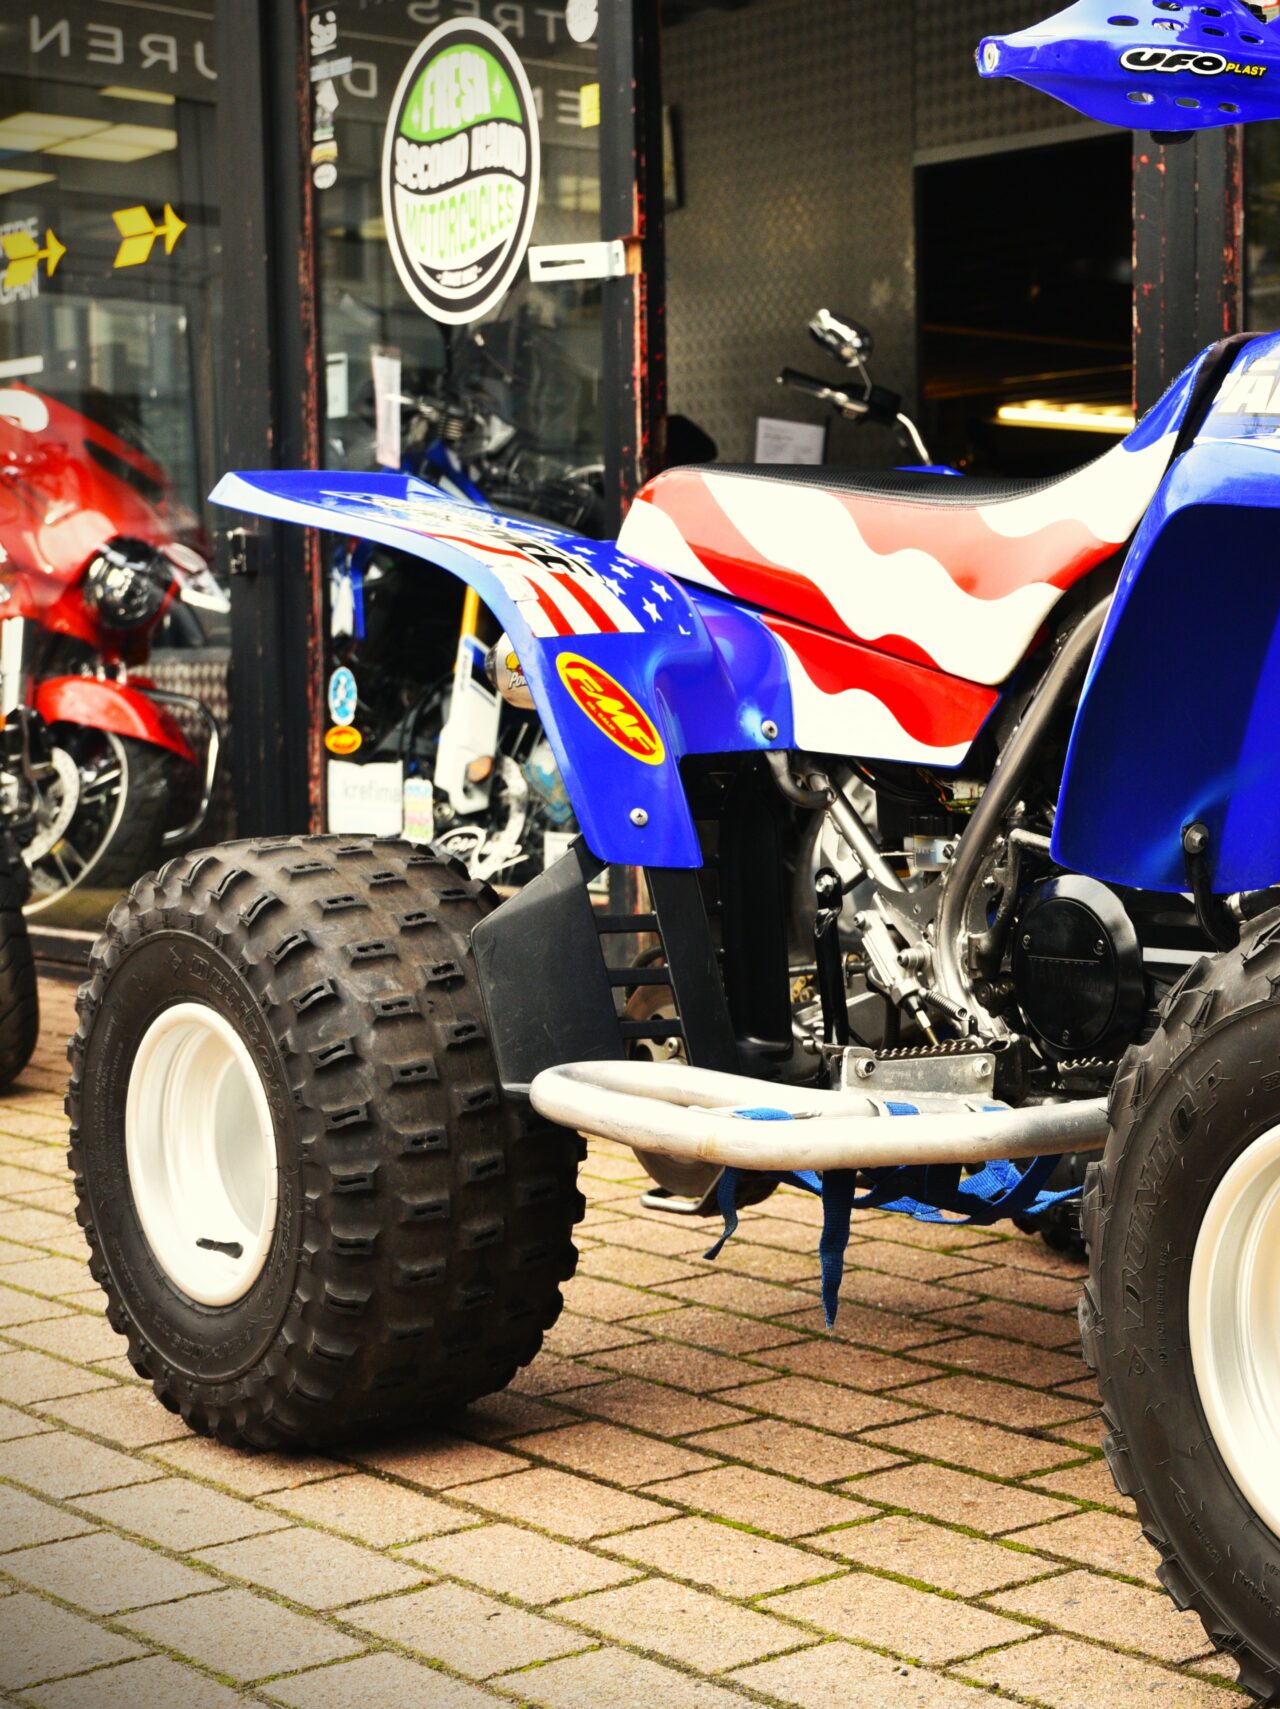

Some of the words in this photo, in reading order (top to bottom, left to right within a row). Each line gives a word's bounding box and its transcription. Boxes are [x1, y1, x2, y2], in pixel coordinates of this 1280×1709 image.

[1120, 47, 1227, 75] UFO
[1225, 62, 1267, 77] PLAST
[564, 667, 659, 751] FMF
